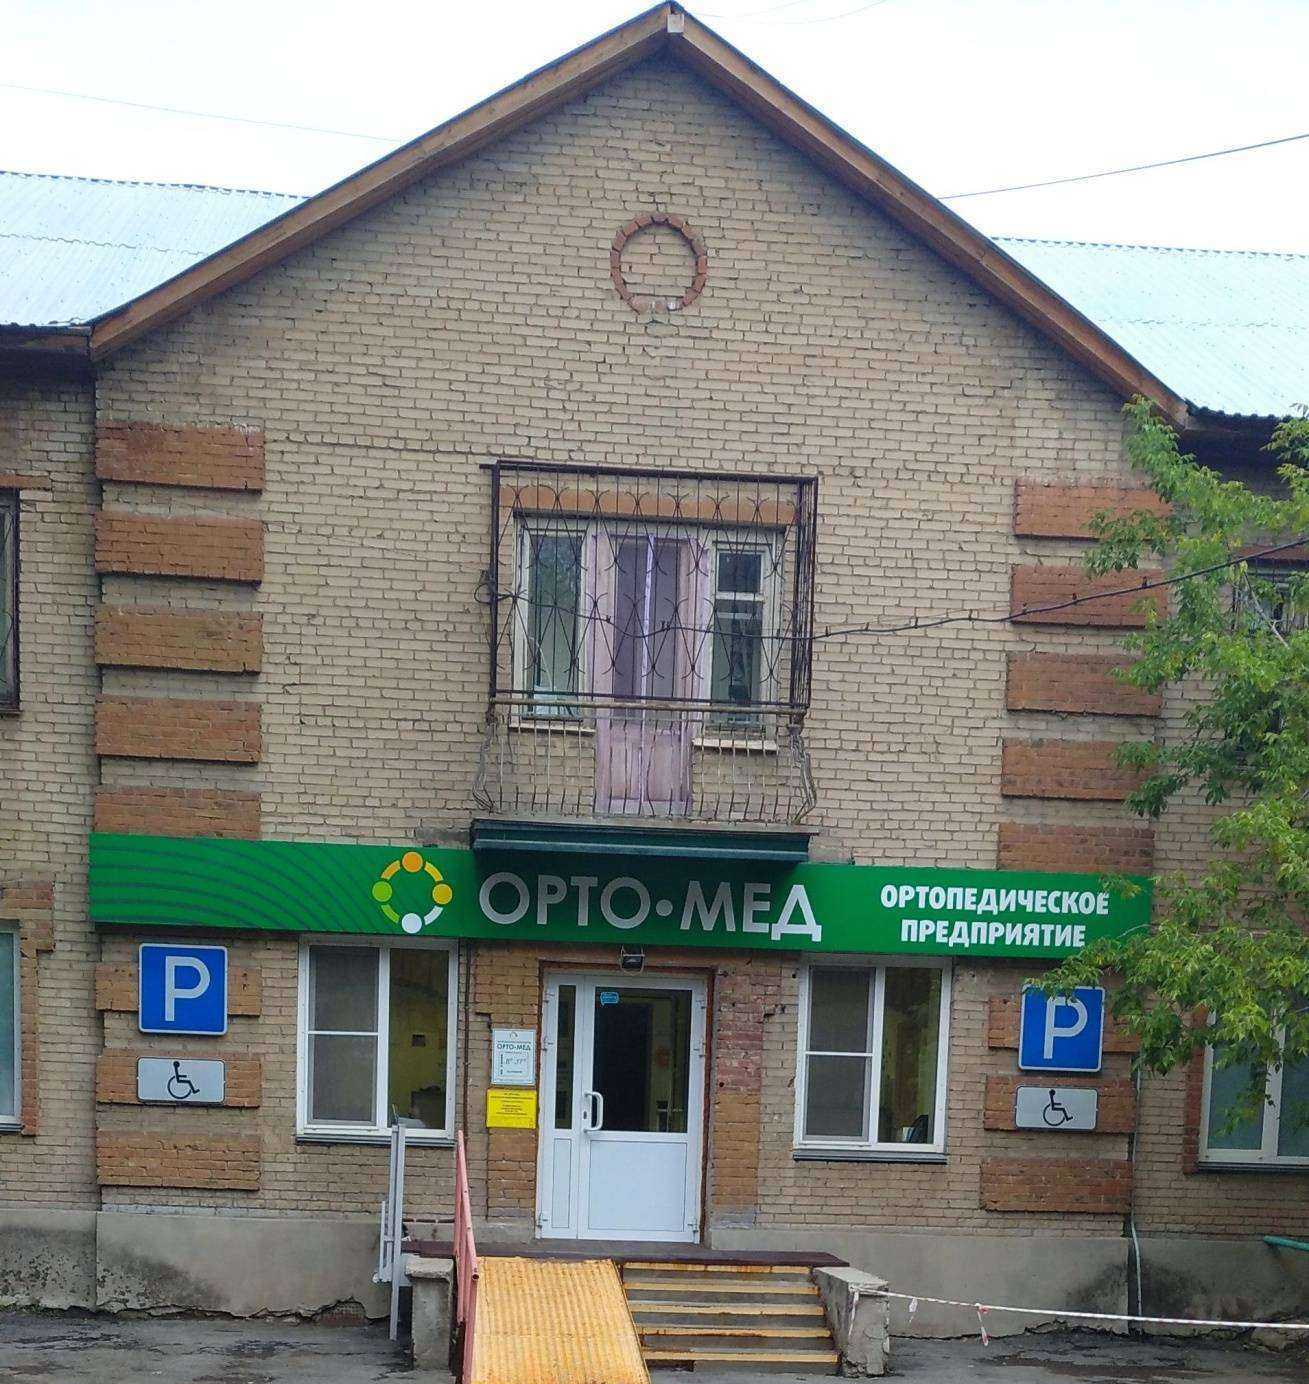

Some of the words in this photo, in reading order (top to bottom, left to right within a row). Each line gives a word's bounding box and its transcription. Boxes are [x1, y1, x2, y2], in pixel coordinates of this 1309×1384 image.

[880, 884, 1110, 915] ОРТОПЕДИЧЕСКОЕ
[901, 919, 1086, 948] ПРЕДПРИЯТИЕ
[165, 956, 211, 1021] P
[1043, 996, 1088, 1059] P
